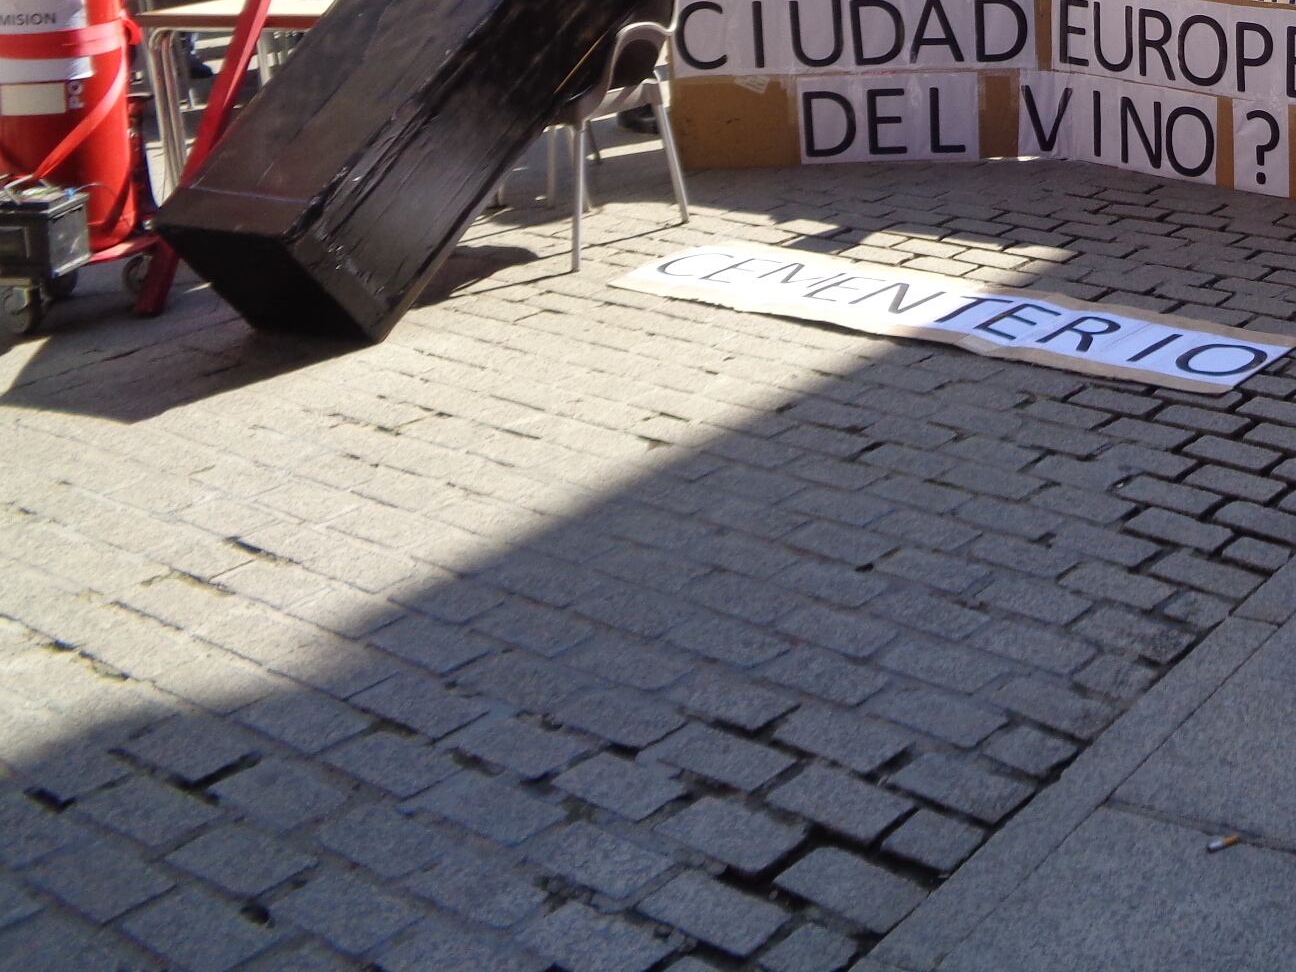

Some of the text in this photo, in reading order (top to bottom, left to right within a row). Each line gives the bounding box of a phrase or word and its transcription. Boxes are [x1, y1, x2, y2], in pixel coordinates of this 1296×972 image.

[803, 87, 967, 159] DEL
[1020, 86, 1216, 179] VINO
[656, 251, 1270, 378] CEMENTERIO
